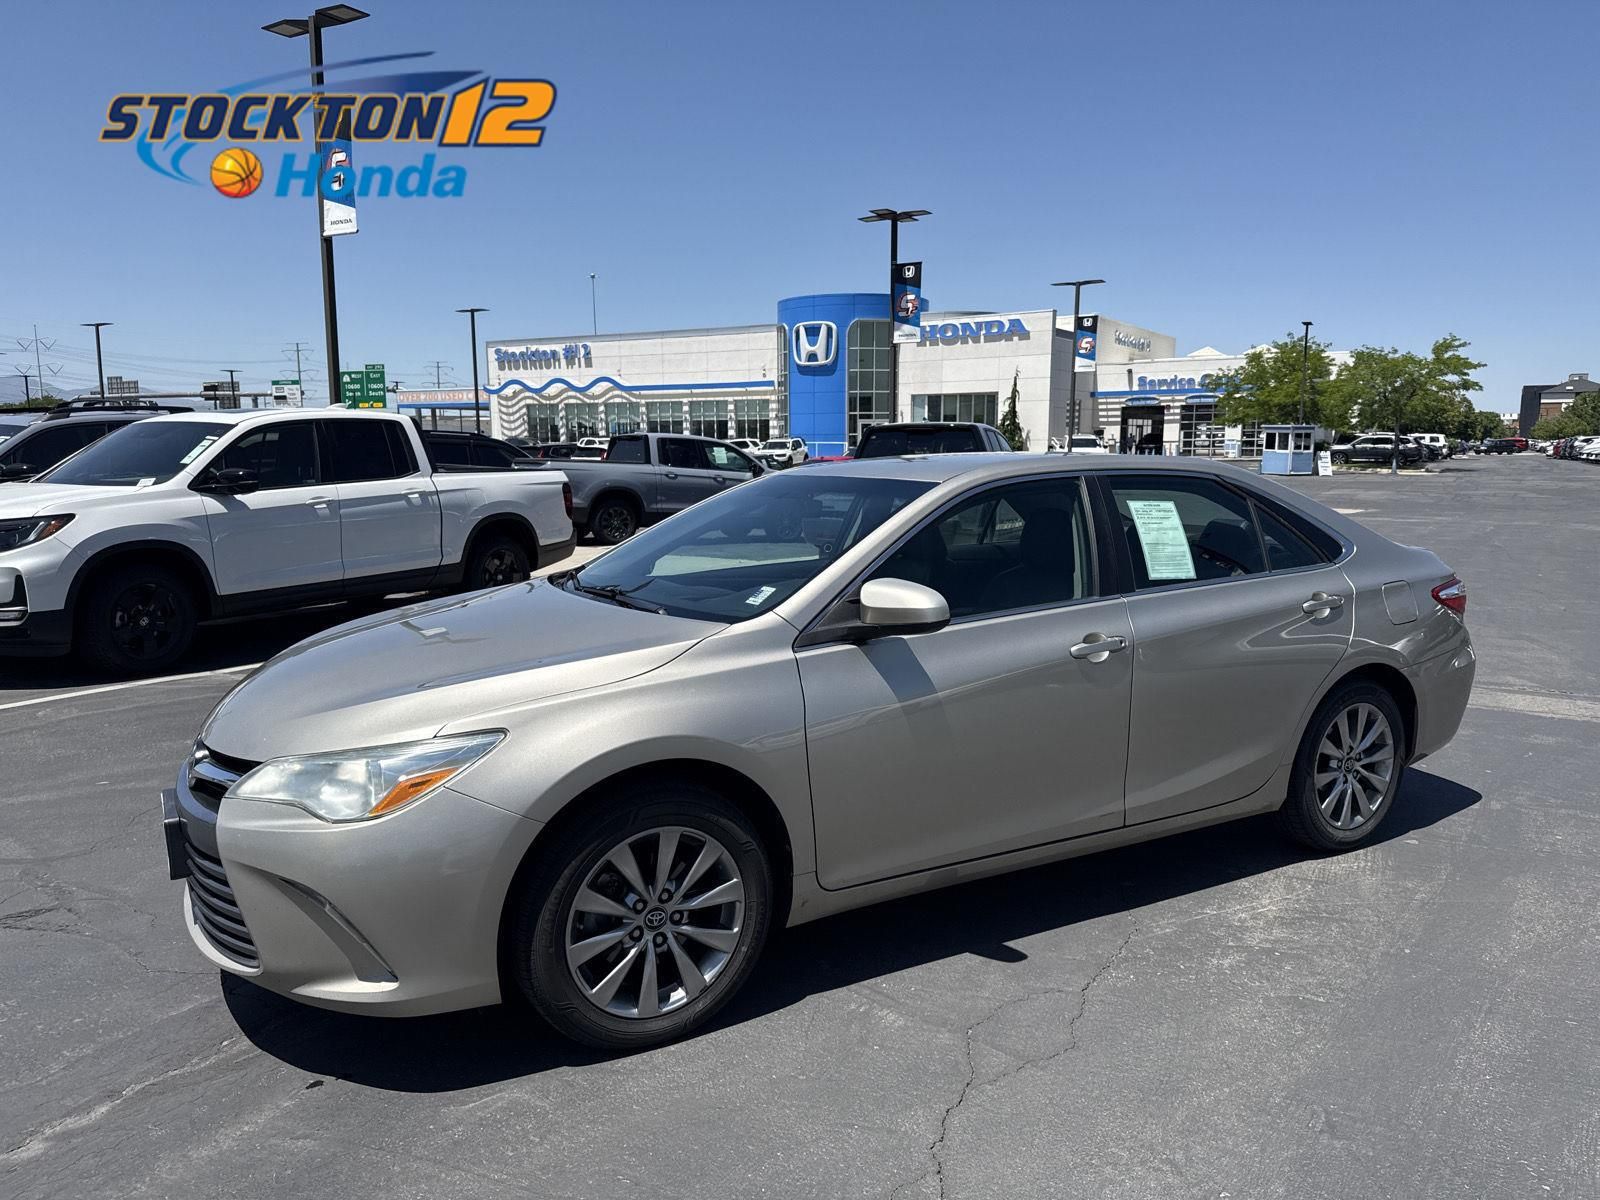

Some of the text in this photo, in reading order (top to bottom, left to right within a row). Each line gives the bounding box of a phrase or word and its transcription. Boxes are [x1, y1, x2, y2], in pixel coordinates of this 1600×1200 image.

[330, 218, 353, 226] HONDA
[920, 318, 1027, 340] HONDA
[494, 342, 592, 362] Stockton #12
[1138, 375, 1196, 389] Service
[399, 392, 421, 402] OVER
[440, 391, 464, 401] USED
